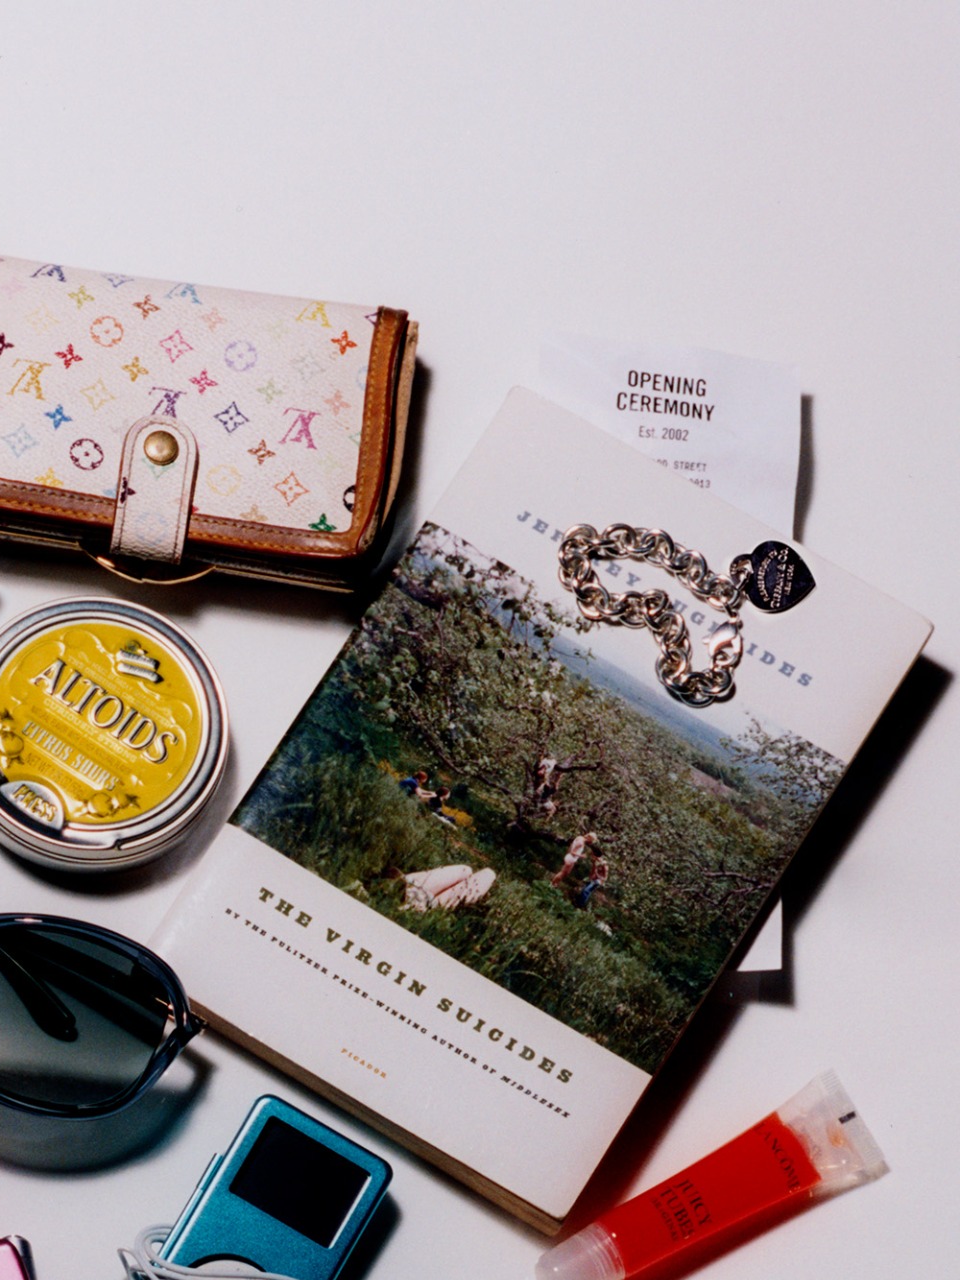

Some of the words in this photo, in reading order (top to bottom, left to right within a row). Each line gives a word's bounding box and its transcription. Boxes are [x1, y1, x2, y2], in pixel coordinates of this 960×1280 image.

[616, 391, 715, 421] CEREMONY
[627, 369, 707, 397] OPENING
[638, 426, 659, 440] Est.
[661, 427, 689, 441] 2002
[673, 460, 707, 473] STREET
[516, 510, 642, 587] JEFEY
[29, 657, 178, 764] ALTOIDS
[43, 698, 98, 738] CURIOUSLY
[97, 732, 138, 763] STRONG
[21, 719, 73, 762] CITRUS
[71, 753, 120, 792] SOURS
[10, 783, 59, 824] PRESS
[259, 886, 313, 929] THE
[325, 927, 428, 998] VIRGIN
[436, 997, 574, 1084] SUICIDES
[225, 907, 240, 920] BY
[244, 919, 267, 937] THE
[270, 935, 328, 975] PULITZER
[332, 973, 428, 1035] PRIZE-WINNING
[431, 1034, 478, 1065] AUTHOR
[482, 1063, 497, 1075] OF
[499, 1074, 572, 1119] MIDDLESEX
[340, 1047, 388, 1080] PICADOR
[673, 1178, 715, 1227] JUICY
